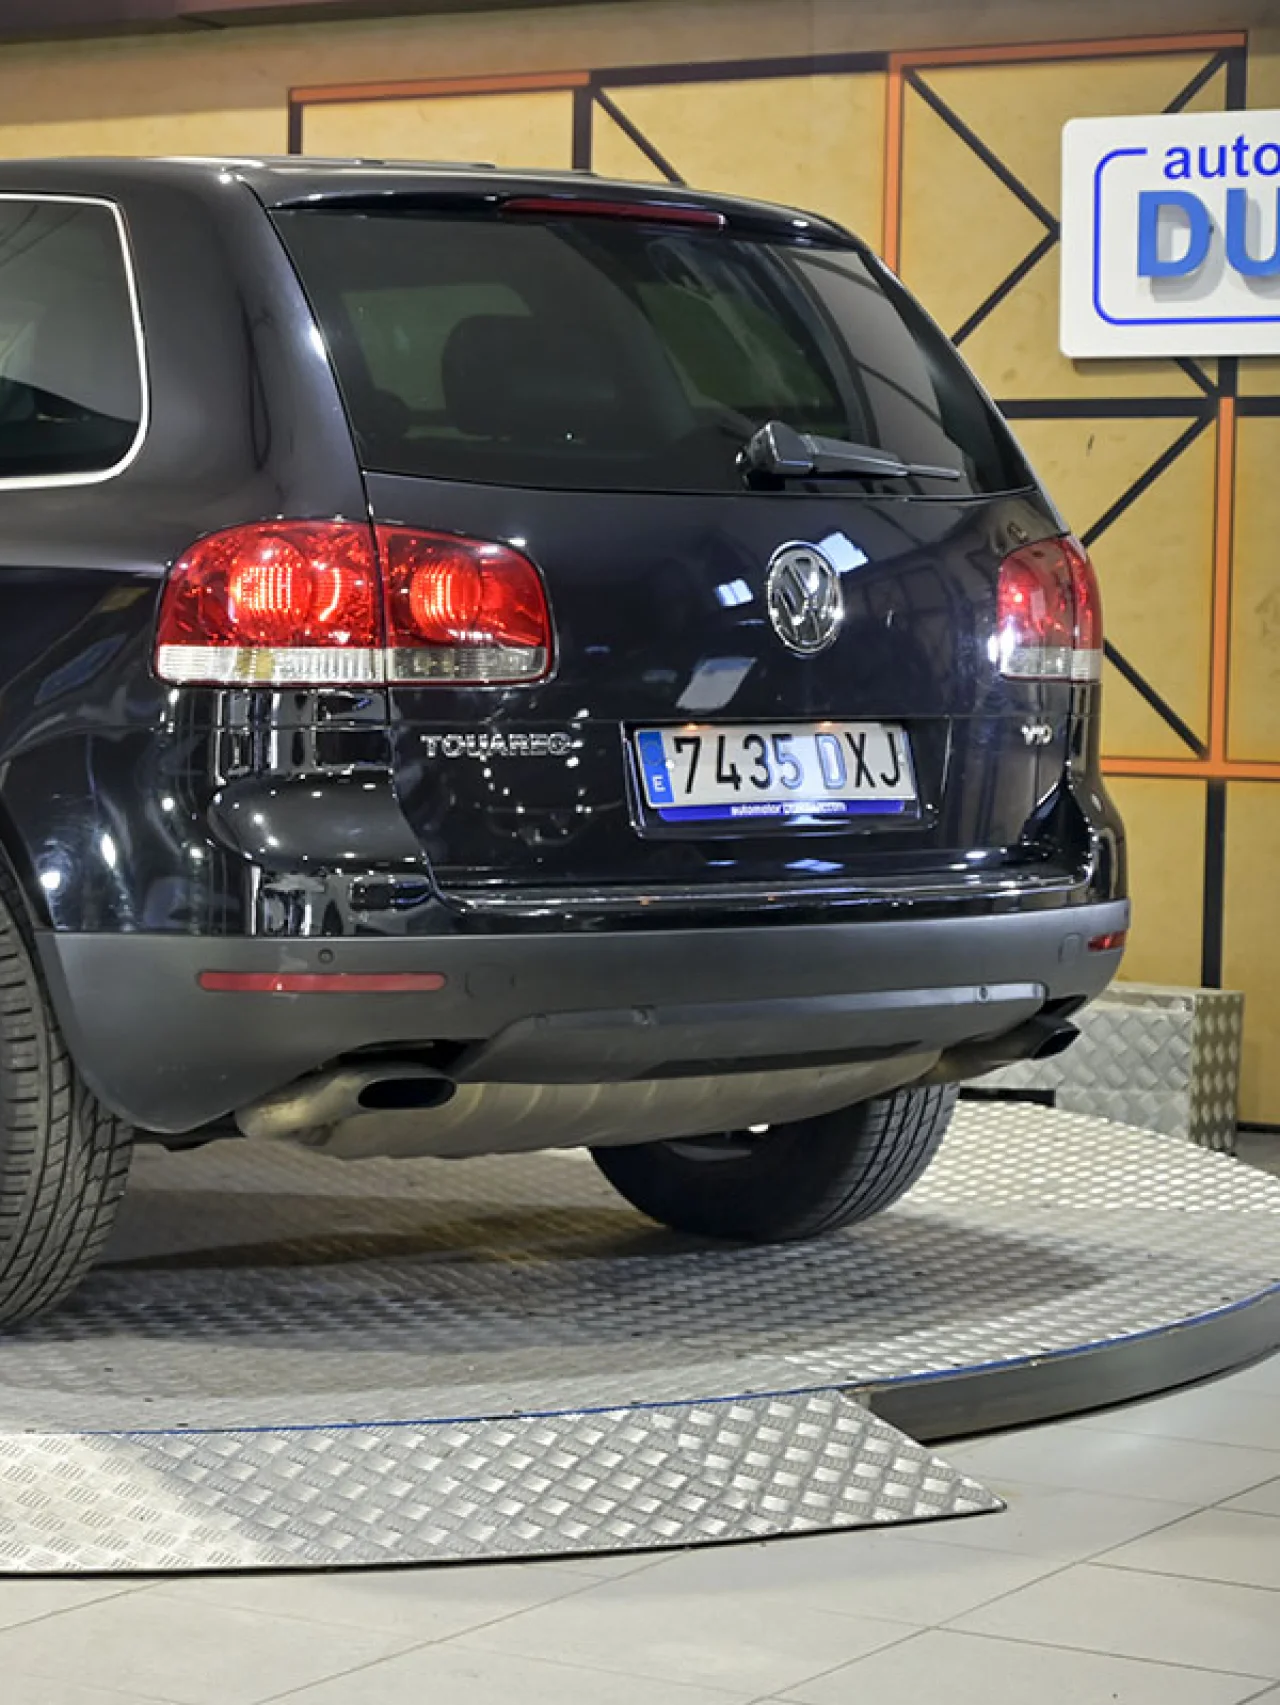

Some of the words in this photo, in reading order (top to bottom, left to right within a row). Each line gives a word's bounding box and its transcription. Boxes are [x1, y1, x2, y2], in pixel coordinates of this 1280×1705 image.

[1163, 134, 1280, 179] auto
[1137, 187, 1280, 278] DU
[652, 774, 666, 793] E
[674, 733, 804, 794] 7435
[815, 731, 901, 789] DXJ
